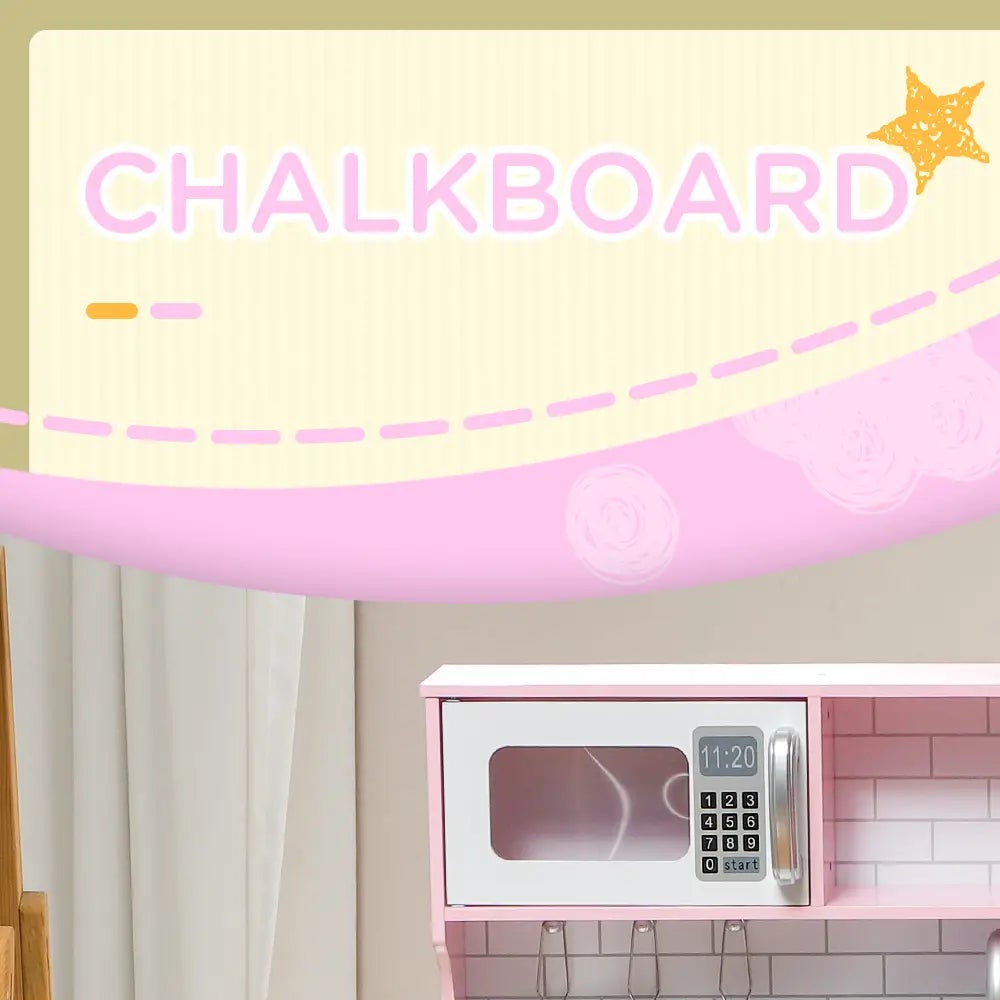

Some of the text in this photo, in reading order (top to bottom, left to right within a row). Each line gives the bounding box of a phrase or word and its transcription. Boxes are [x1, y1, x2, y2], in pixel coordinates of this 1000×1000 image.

[701, 745, 755, 769] 11:20
[705, 795, 755, 807] 1 2 3
[704, 816, 755, 829] 4 5 6
[705, 838, 755, 850] 7 8 9
[705, 859, 759, 871] 0 start
